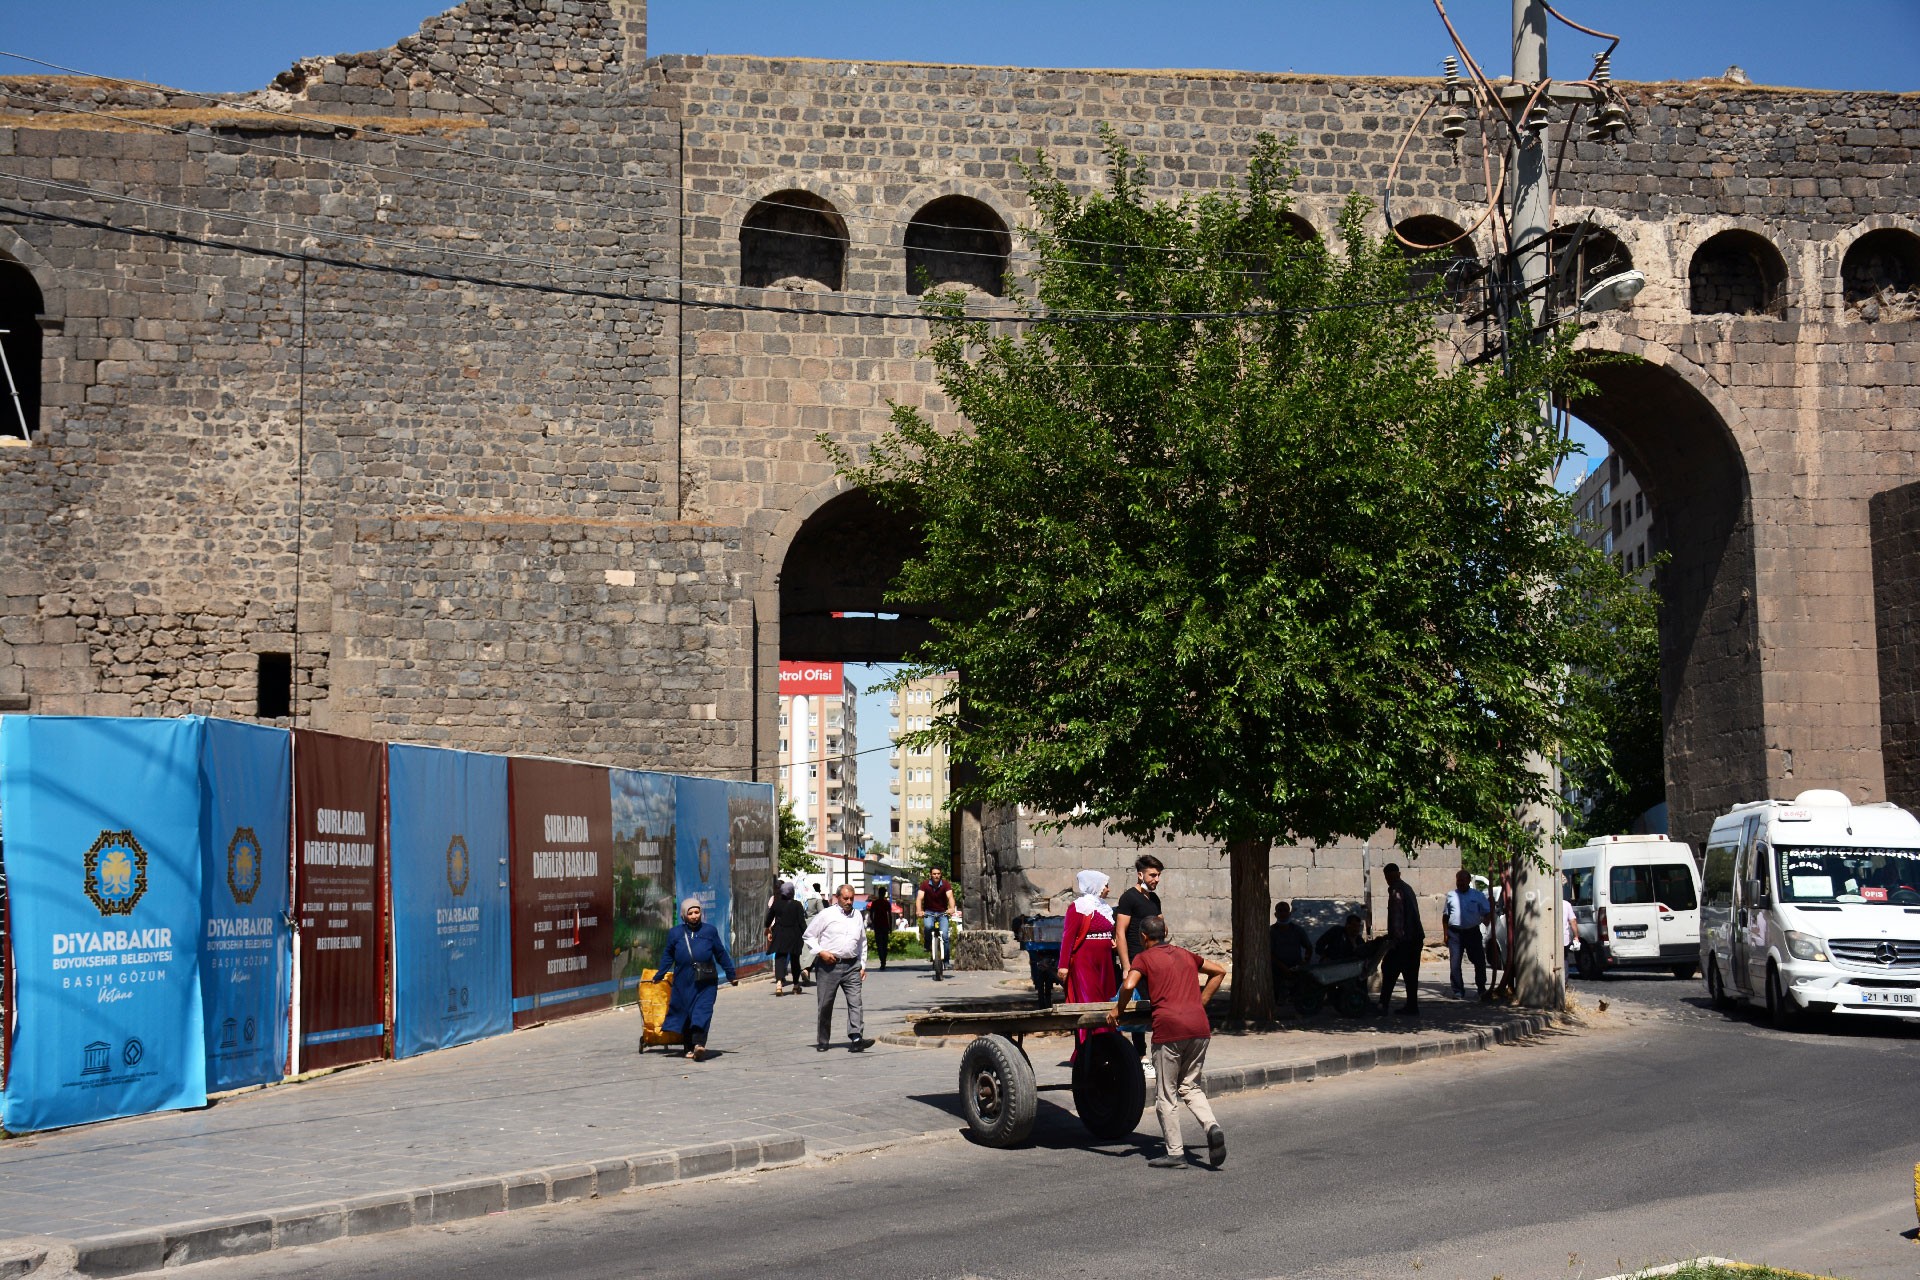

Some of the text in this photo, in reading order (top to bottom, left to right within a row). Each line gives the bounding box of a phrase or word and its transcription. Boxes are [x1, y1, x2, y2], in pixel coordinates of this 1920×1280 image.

[779, 668, 832, 681] etrol Ofisi
[317, 808, 366, 836] SURLARDA
[544, 814, 589, 843] SURLARDA
[304, 840, 374, 869] DİRİLİŞ BAŞLADI
[533, 851, 598, 881] DİRİLİŞ BAŞLADI
[437, 906, 479, 924] DİYARBAKIR
[207, 917, 273, 937] DİYARBAKIR
[52, 927, 173, 955] DİYARBAKIR
[52, 950, 173, 970] BÜYÜKŞEHİR BELEDİYESİ
[119, 969, 166, 984] GÖZÜM
[1867, 993, 1877, 1001] 21
